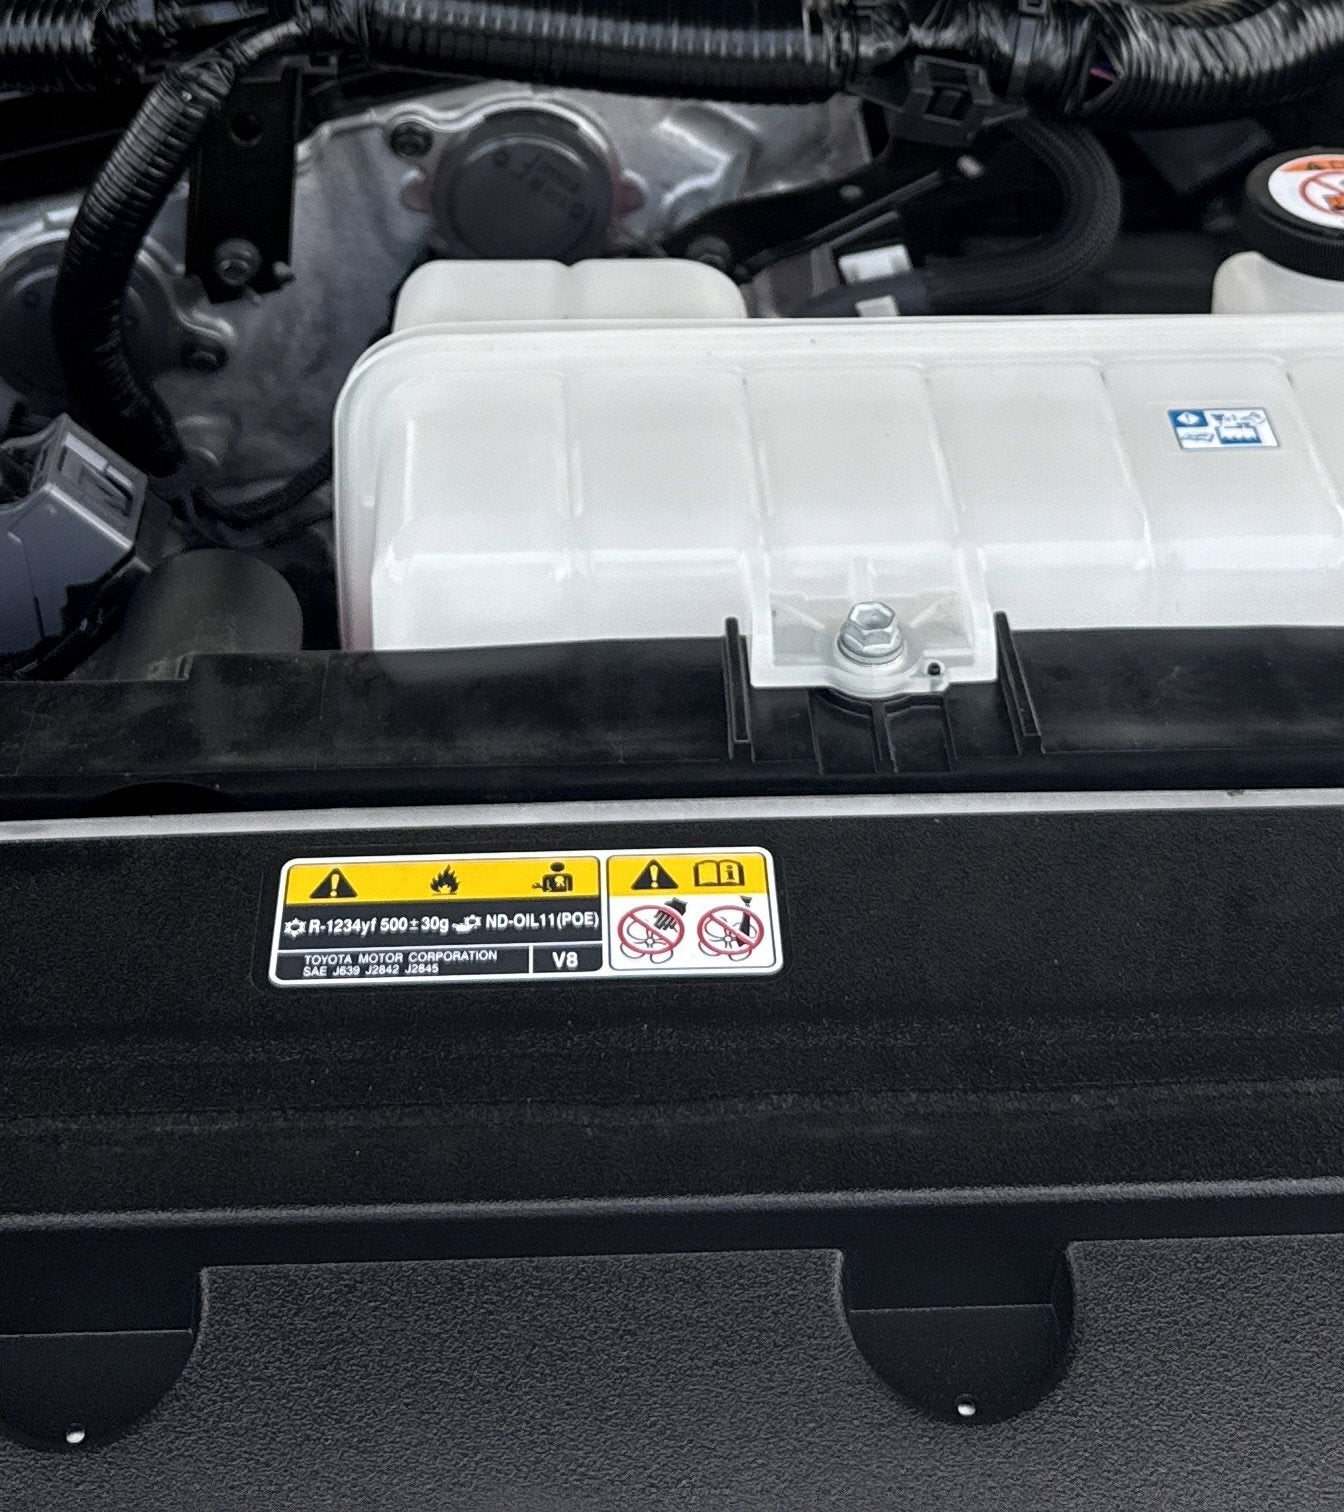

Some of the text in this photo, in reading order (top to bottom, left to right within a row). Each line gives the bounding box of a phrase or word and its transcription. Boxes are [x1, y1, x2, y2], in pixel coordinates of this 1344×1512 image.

[308, 917, 377, 937] R-1234yf
[485, 911, 600, 930] ND-OIL11(POE)
[304, 949, 498, 966] TOYOTA MOTOR CORPORATION
[552, 951, 578, 969] V8
[302, 965, 328, 977] SAE
[331, 964, 361, 976] J639
[364, 963, 400, 975] J2842
